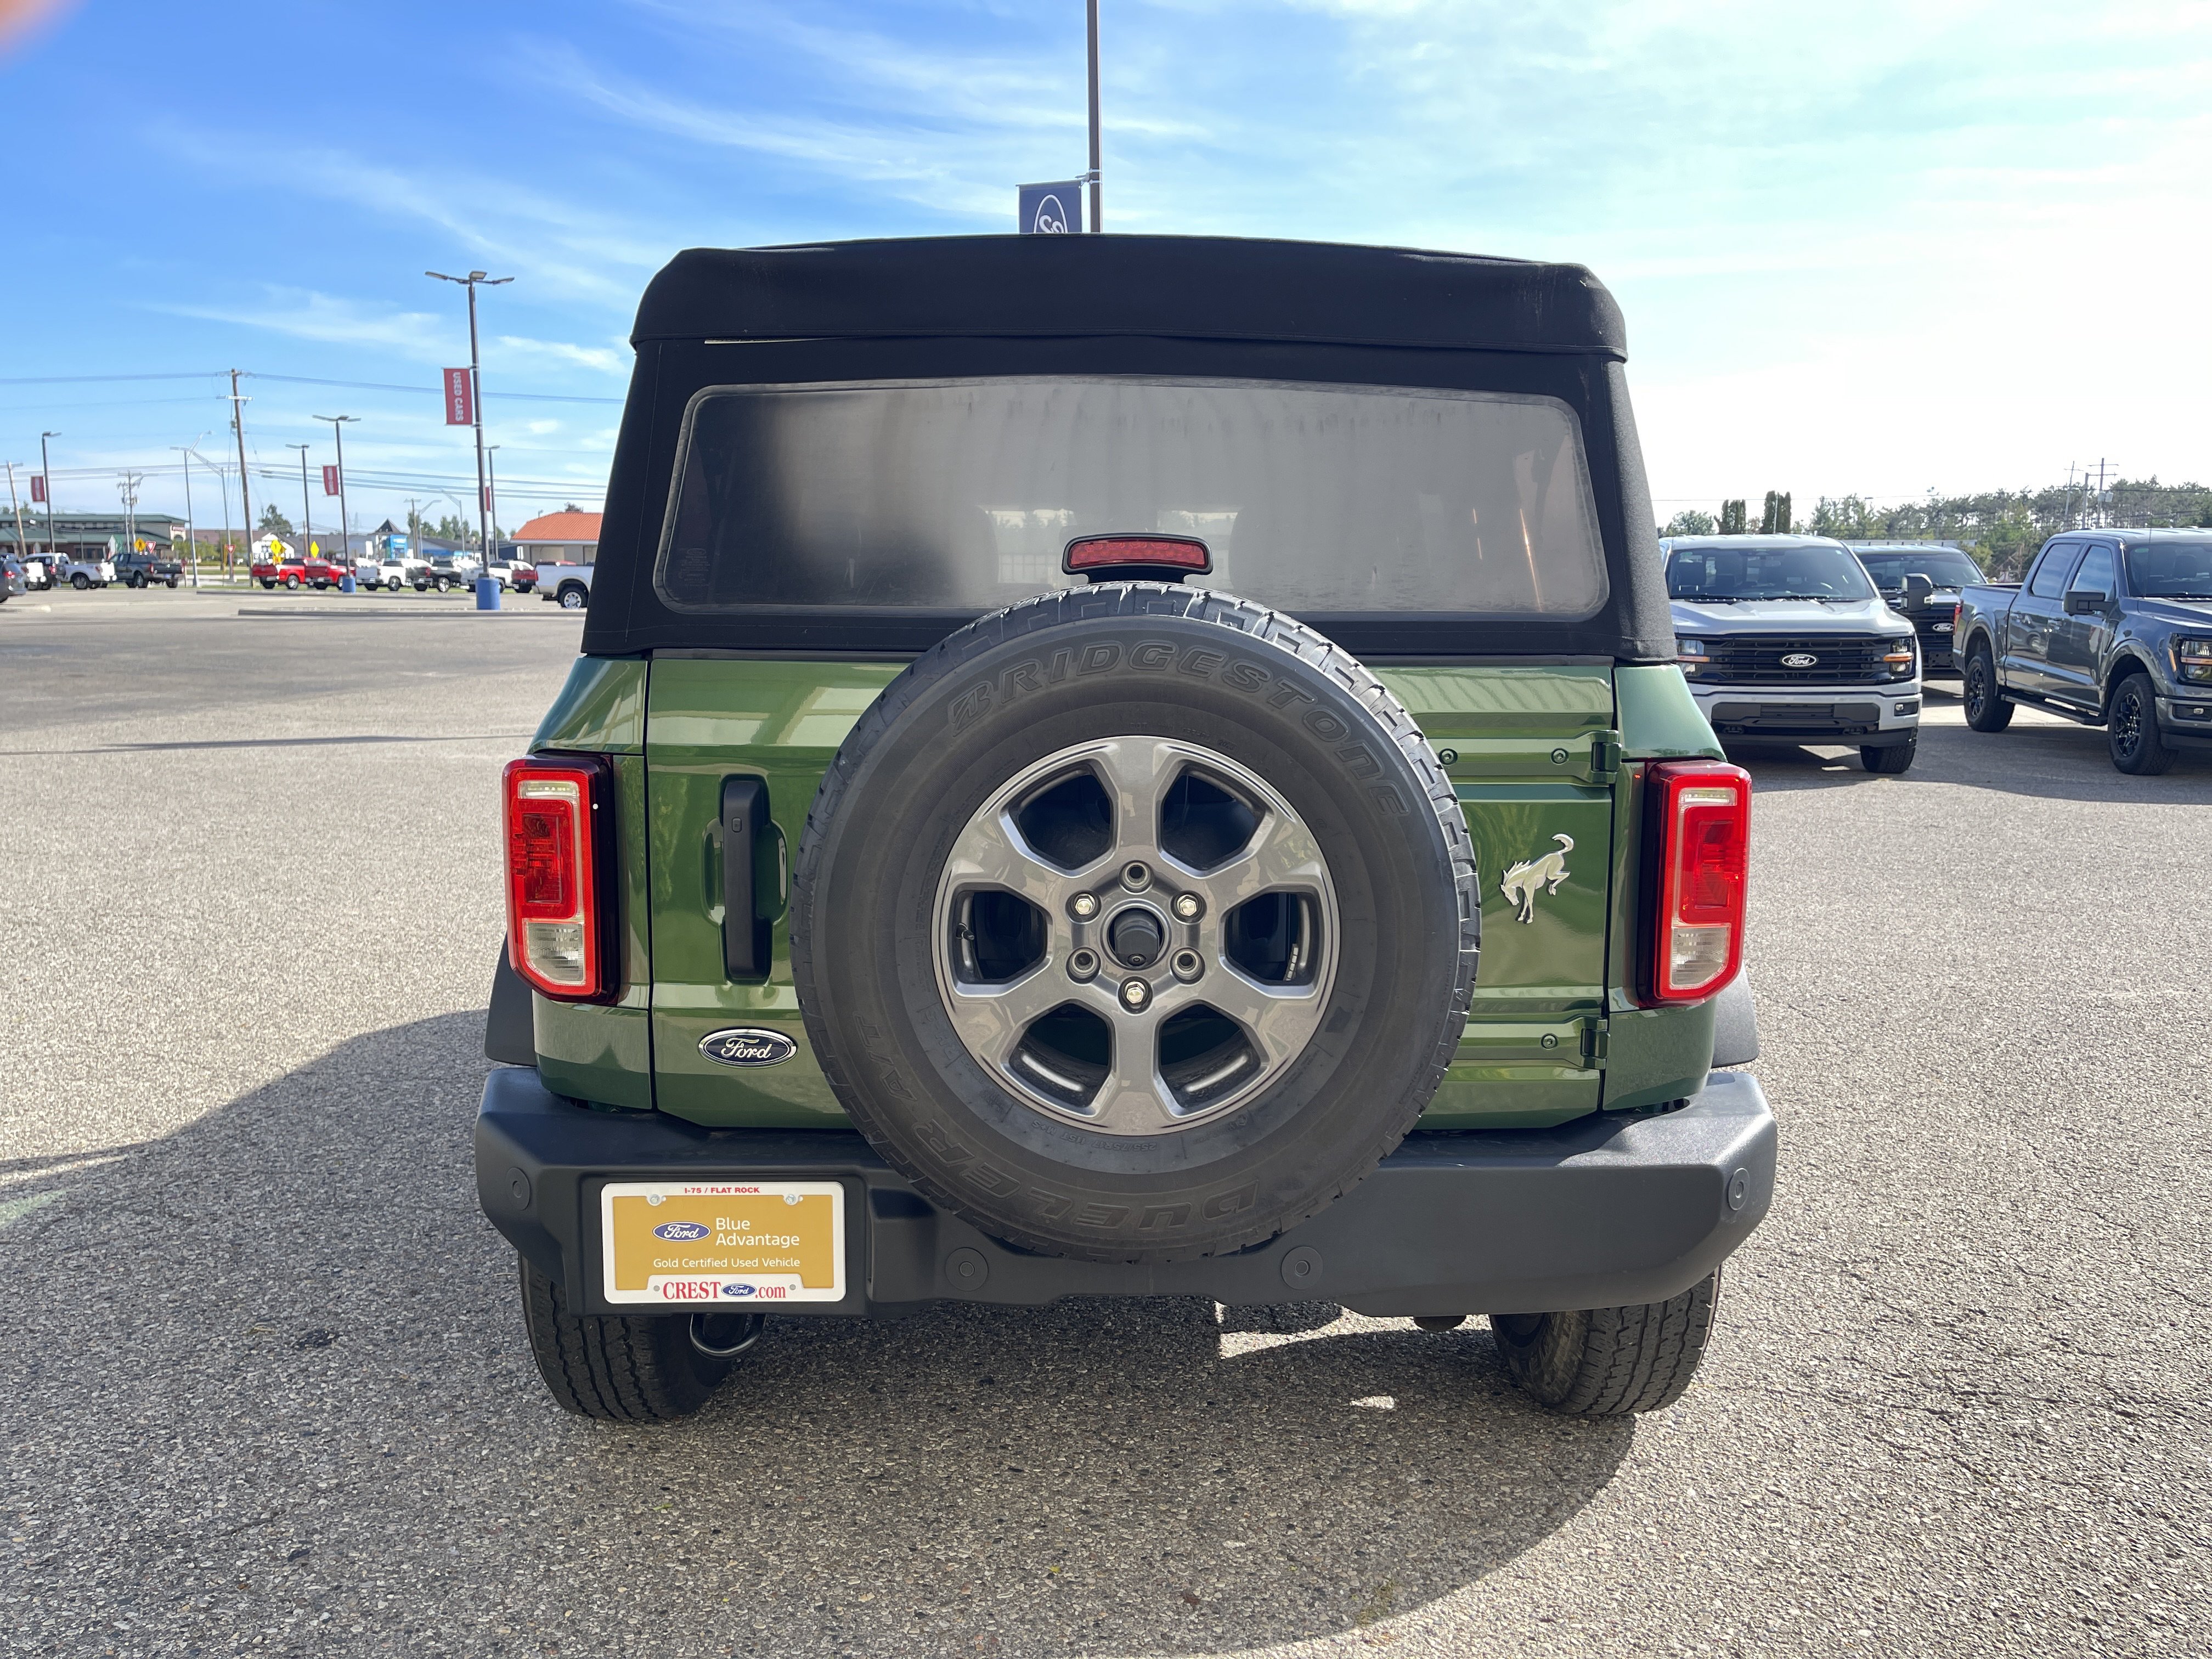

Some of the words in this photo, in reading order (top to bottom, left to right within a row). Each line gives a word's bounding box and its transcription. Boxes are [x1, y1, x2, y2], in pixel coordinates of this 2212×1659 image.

[453, 371, 462, 396] USED
[454, 397, 464, 421] CARS
[1788, 656, 1810, 664] Ford
[948, 640, 1412, 819] BRIDGESTONE
[720, 1037, 772, 1058] Ford
[852, 1011, 920, 1104] A/T
[1032, 1120, 1057, 1136] M+S
[1060, 1132, 1087, 1146] 115T
[1092, 1139, 1158, 1152] 255/75R17
[911, 1117, 1261, 1232] DUELER
[663, 1224, 699, 1239] Ford
[715, 1217, 751, 1231] Blue
[715, 1233, 800, 1248] Advantage
[653, 1258, 679, 1268] Gold
[682, 1258, 728, 1268] Certified
[731, 1258, 759, 1268] Used
[761, 1257, 800, 1267] Vehicle
[663, 1282, 721, 1300] CREST
[727, 1285, 750, 1296] Ford
[755, 1285, 786, 1299] .com
